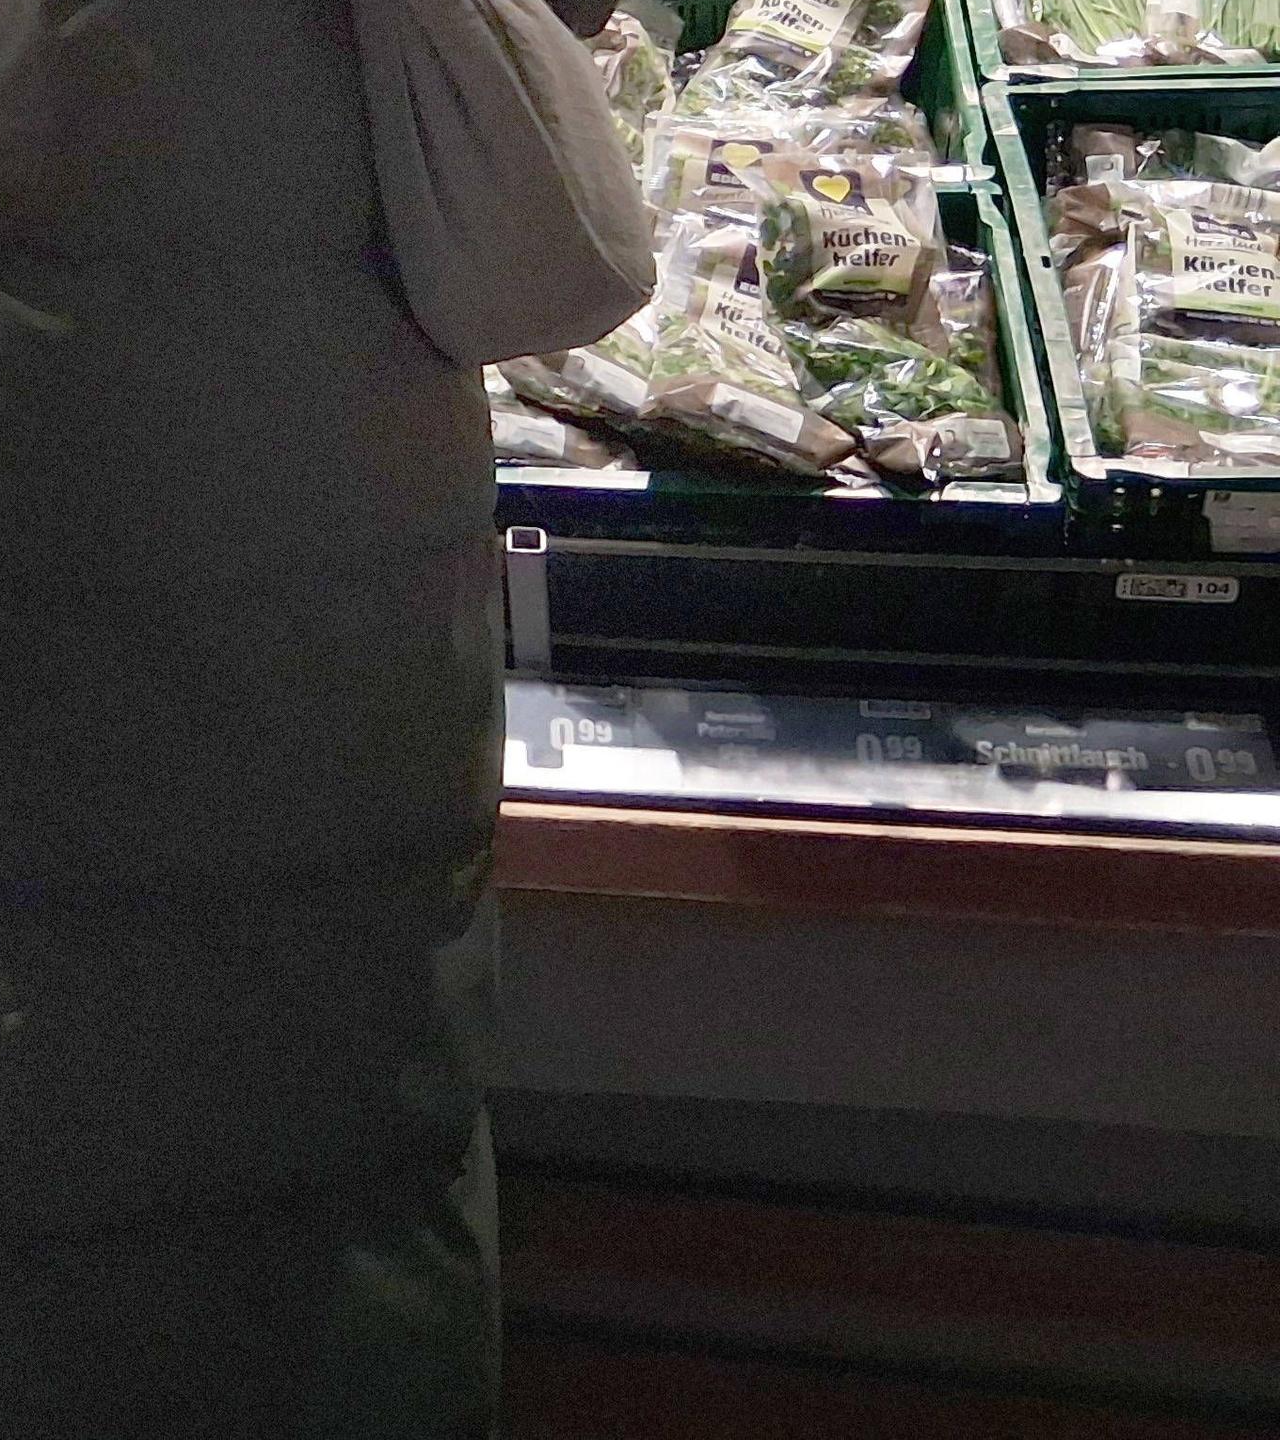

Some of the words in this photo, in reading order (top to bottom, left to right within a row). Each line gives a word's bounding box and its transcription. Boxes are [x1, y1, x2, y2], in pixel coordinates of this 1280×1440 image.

[822, 226, 915, 248] Küchen-
[832, 247, 900, 267] helfer
[549, 716, 613, 751] 099
[975, 741, 1146, 773] Schnittlauch
